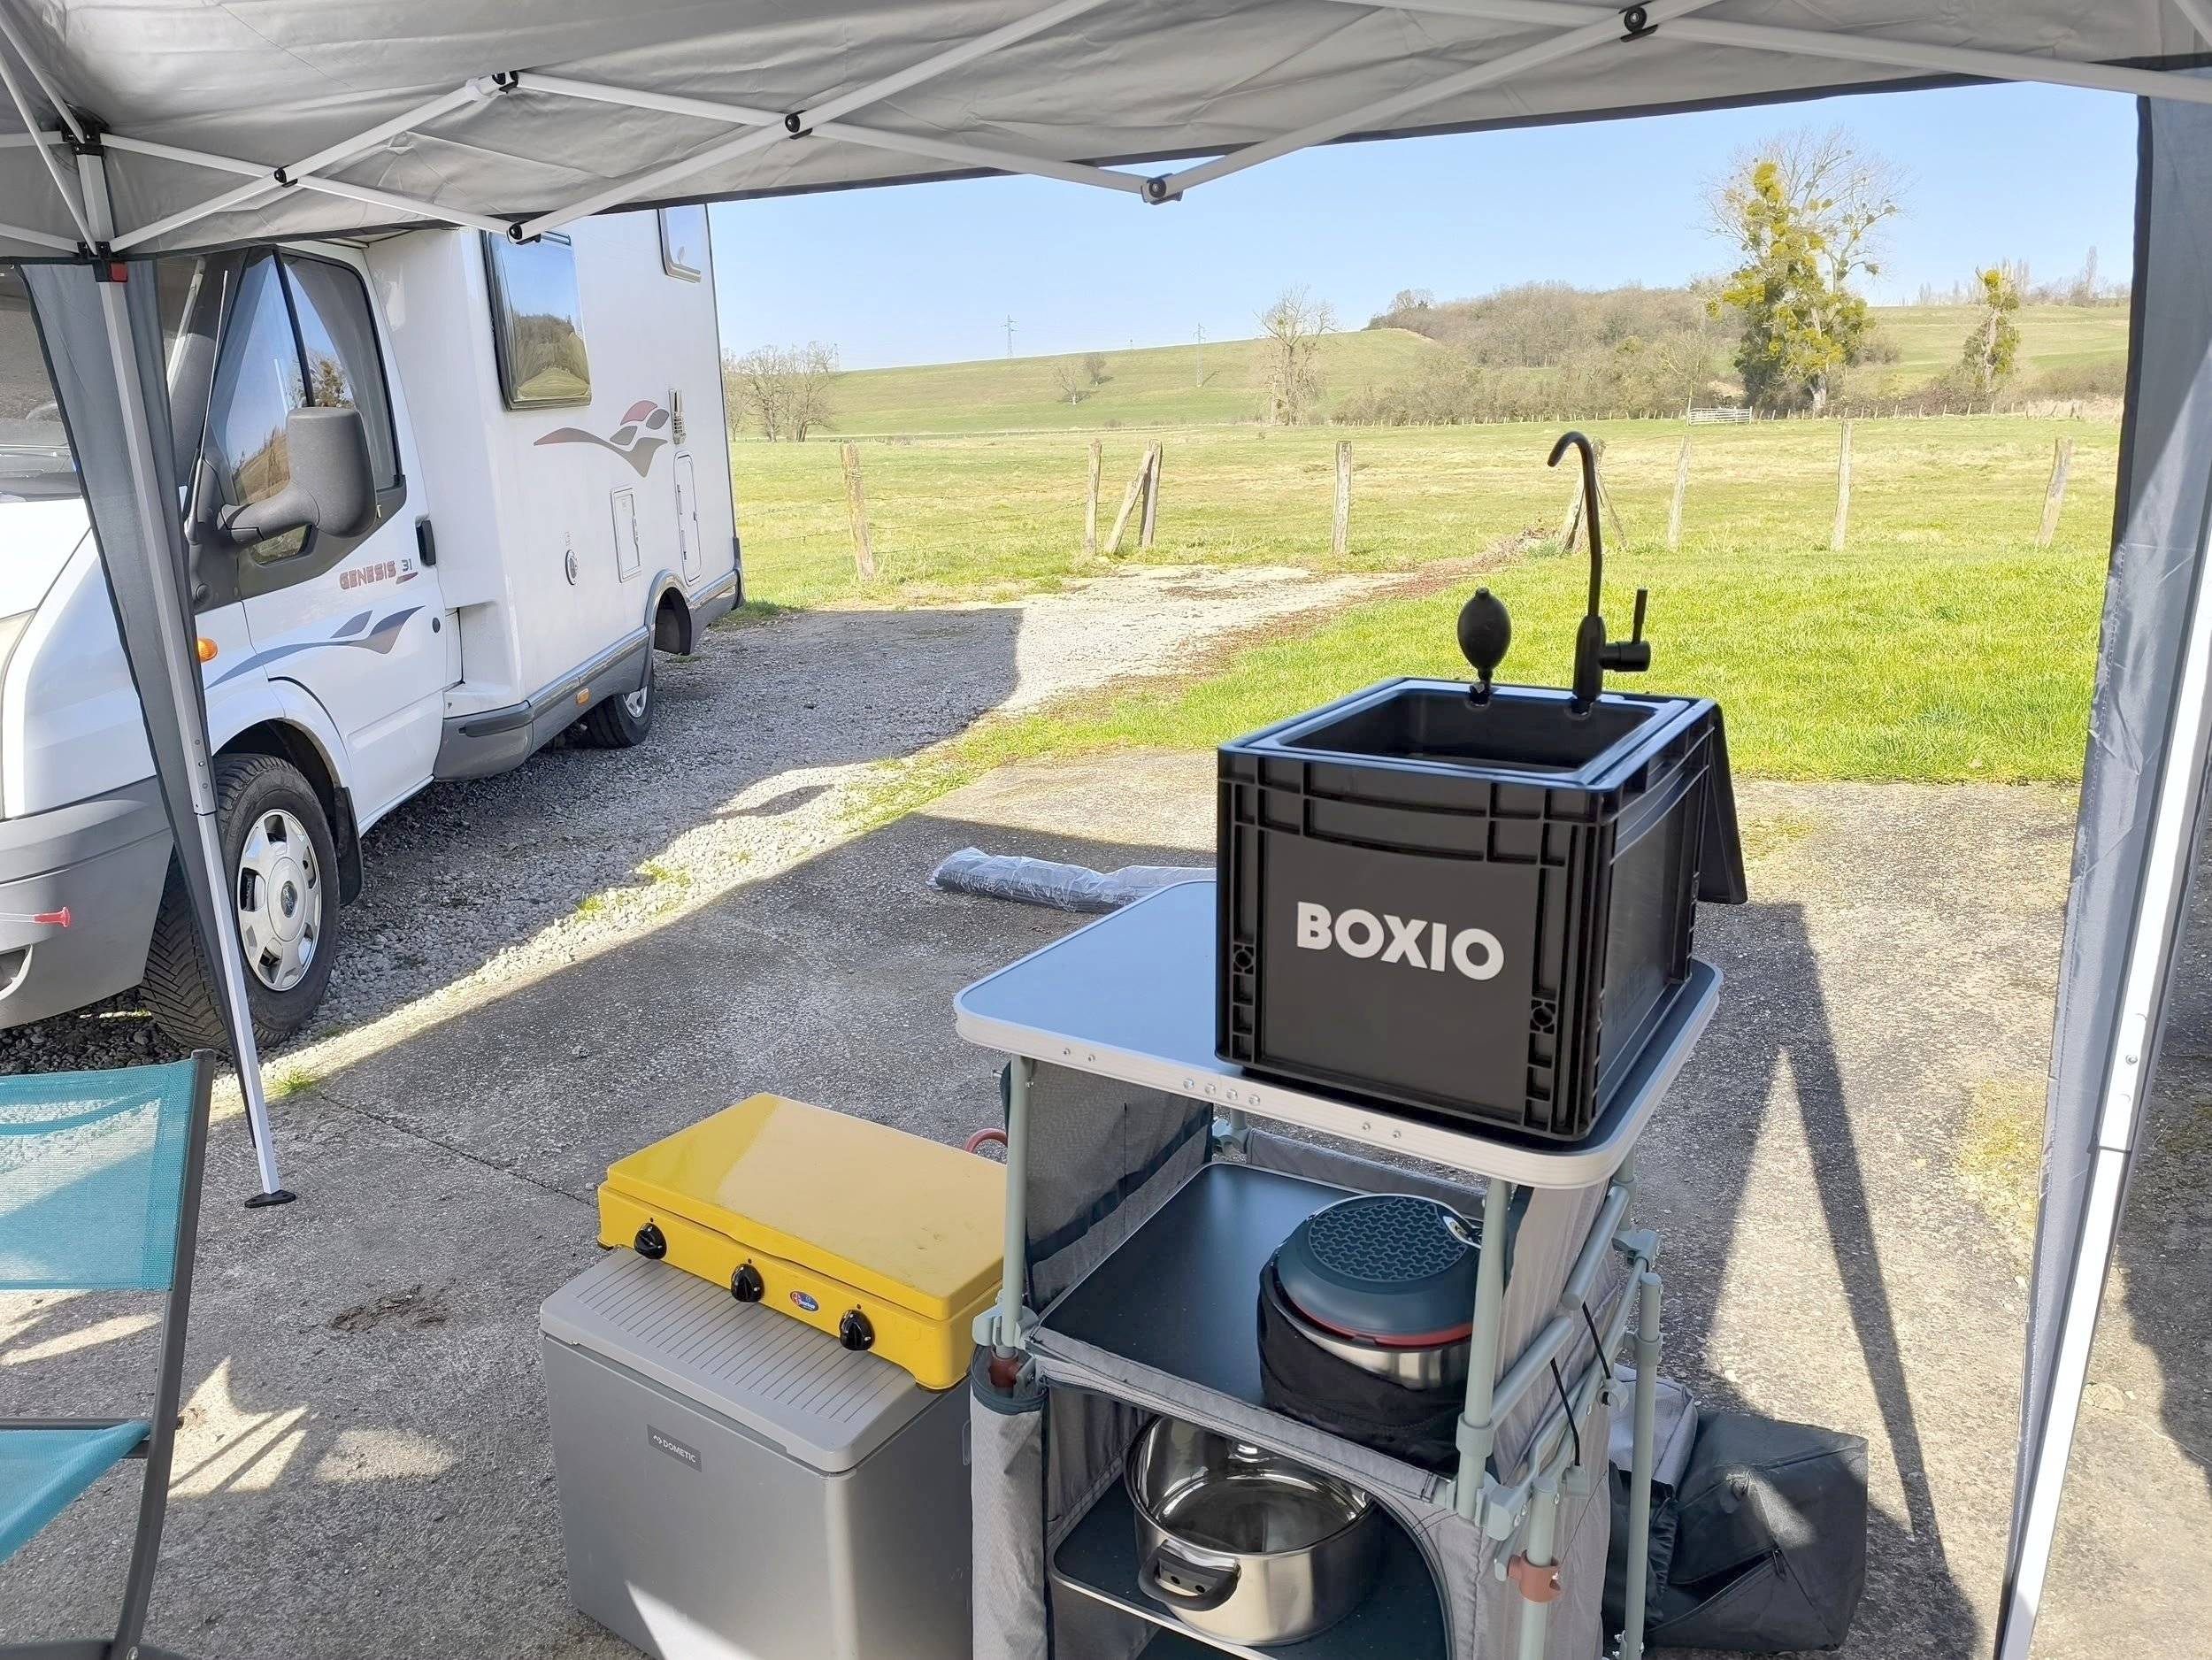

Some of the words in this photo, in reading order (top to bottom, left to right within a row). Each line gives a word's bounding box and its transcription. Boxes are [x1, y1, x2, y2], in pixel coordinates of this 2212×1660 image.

[339, 560, 396, 590] GENESIS
[402, 558, 413, 572] 31
[1297, 901, 1504, 980] BOXIO
[662, 1439, 696, 1463] DOMETIC
